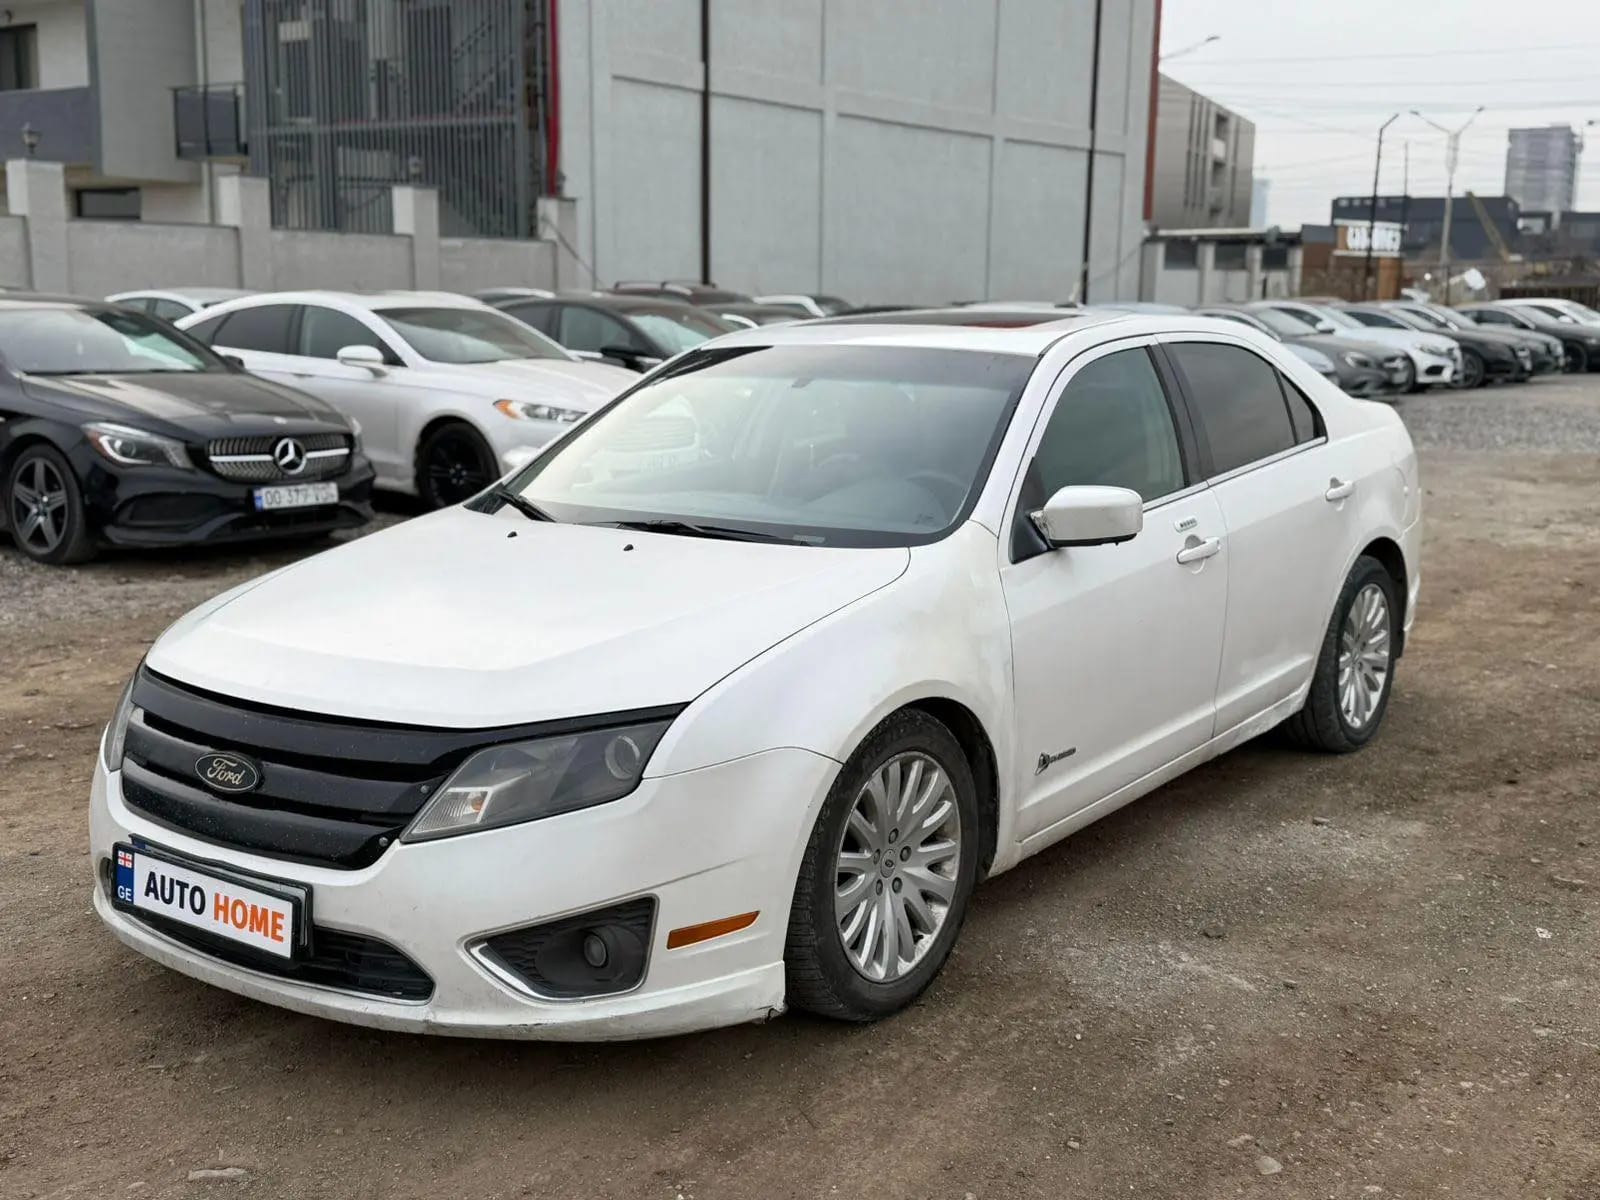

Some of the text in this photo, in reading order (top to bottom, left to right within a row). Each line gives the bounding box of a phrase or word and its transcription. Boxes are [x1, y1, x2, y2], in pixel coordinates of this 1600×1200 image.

[206, 757, 245, 785] Ford
[117, 885, 132, 902] GE
[144, 871, 285, 943] AUTO HOME
